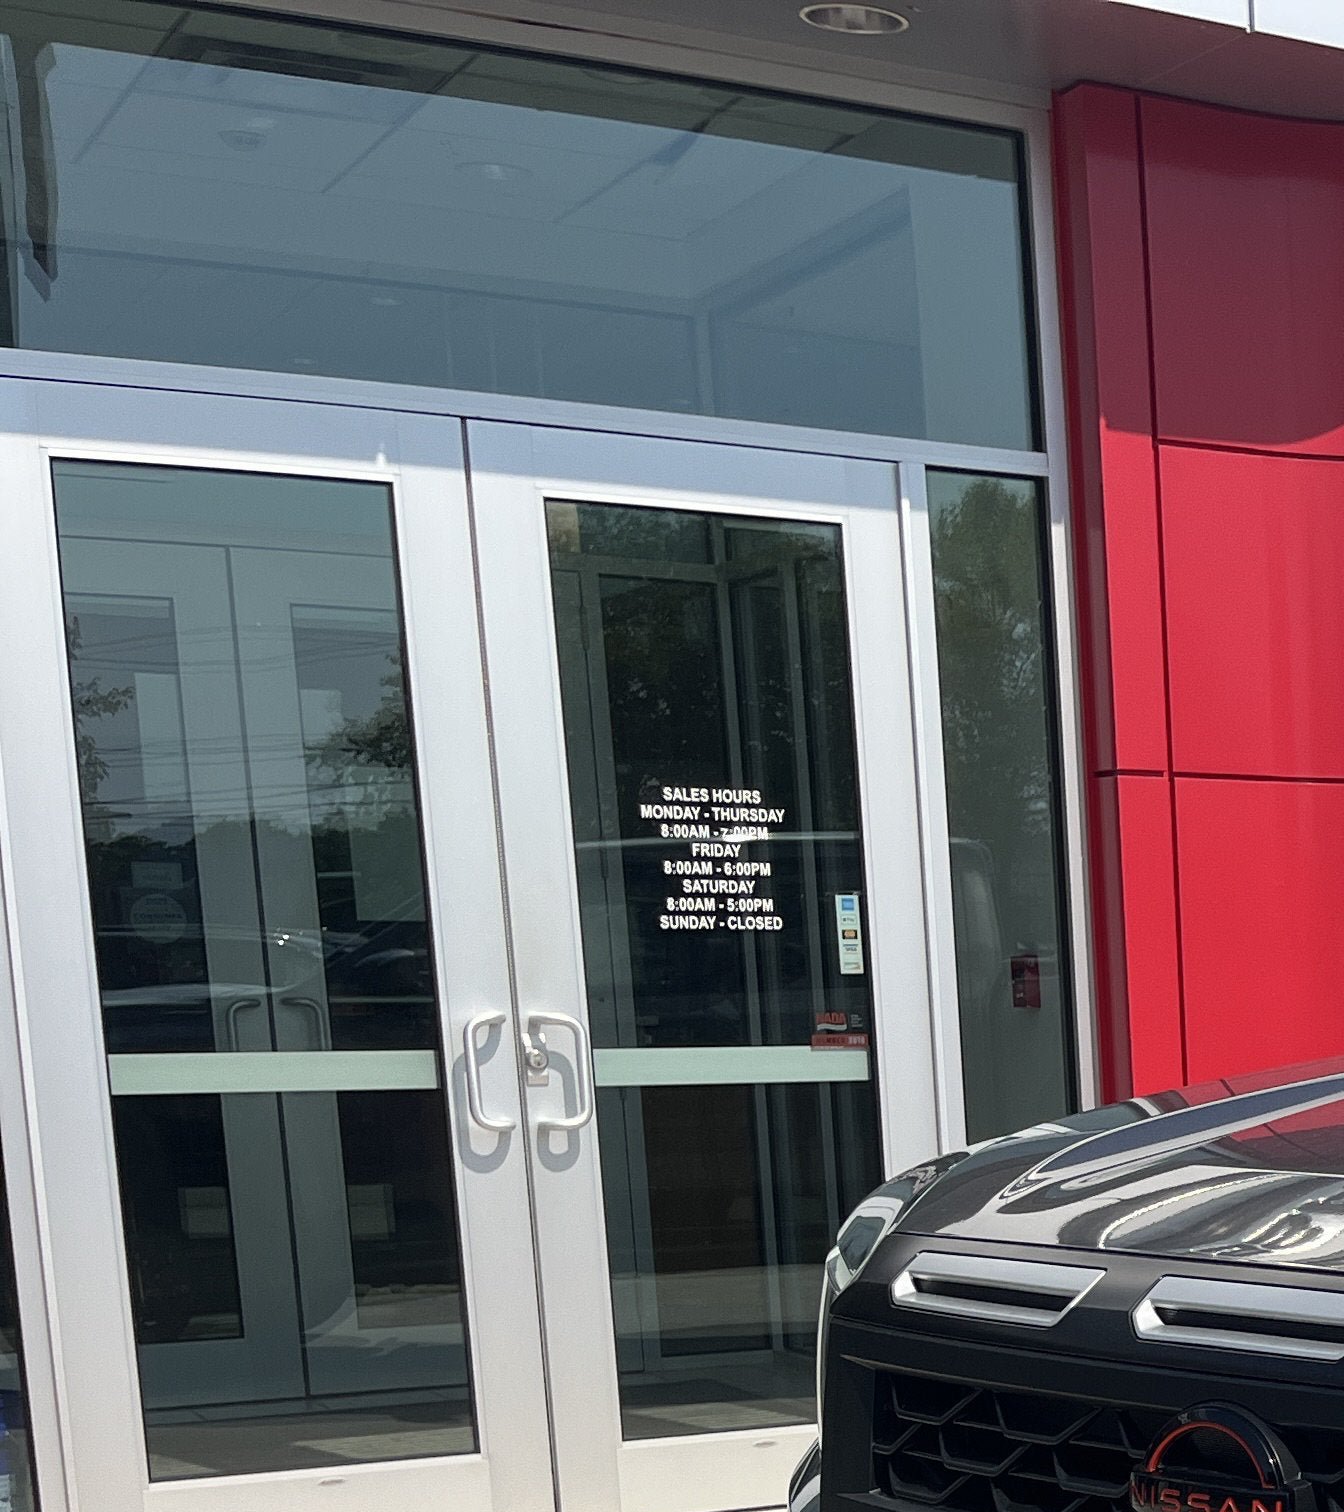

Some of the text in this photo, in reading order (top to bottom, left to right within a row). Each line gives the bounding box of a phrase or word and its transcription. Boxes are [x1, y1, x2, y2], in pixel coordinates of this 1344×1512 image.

[663, 786, 761, 804] SALES HOURS
[640, 804, 700, 820] MONDAY
[711, 807, 785, 823] THURSDAY
[660, 823, 710, 839] 8:00AM
[692, 843, 741, 857] FRIDAY
[664, 860, 713, 875] 8:00AM
[724, 862, 771, 876] 6:00PM
[683, 879, 755, 894] SATURDAY
[666, 897, 716, 911] 8:00AM
[727, 898, 774, 912] 5:00PM
[660, 915, 716, 930] SUNDAY
[727, 916, 783, 930] CLOSED
